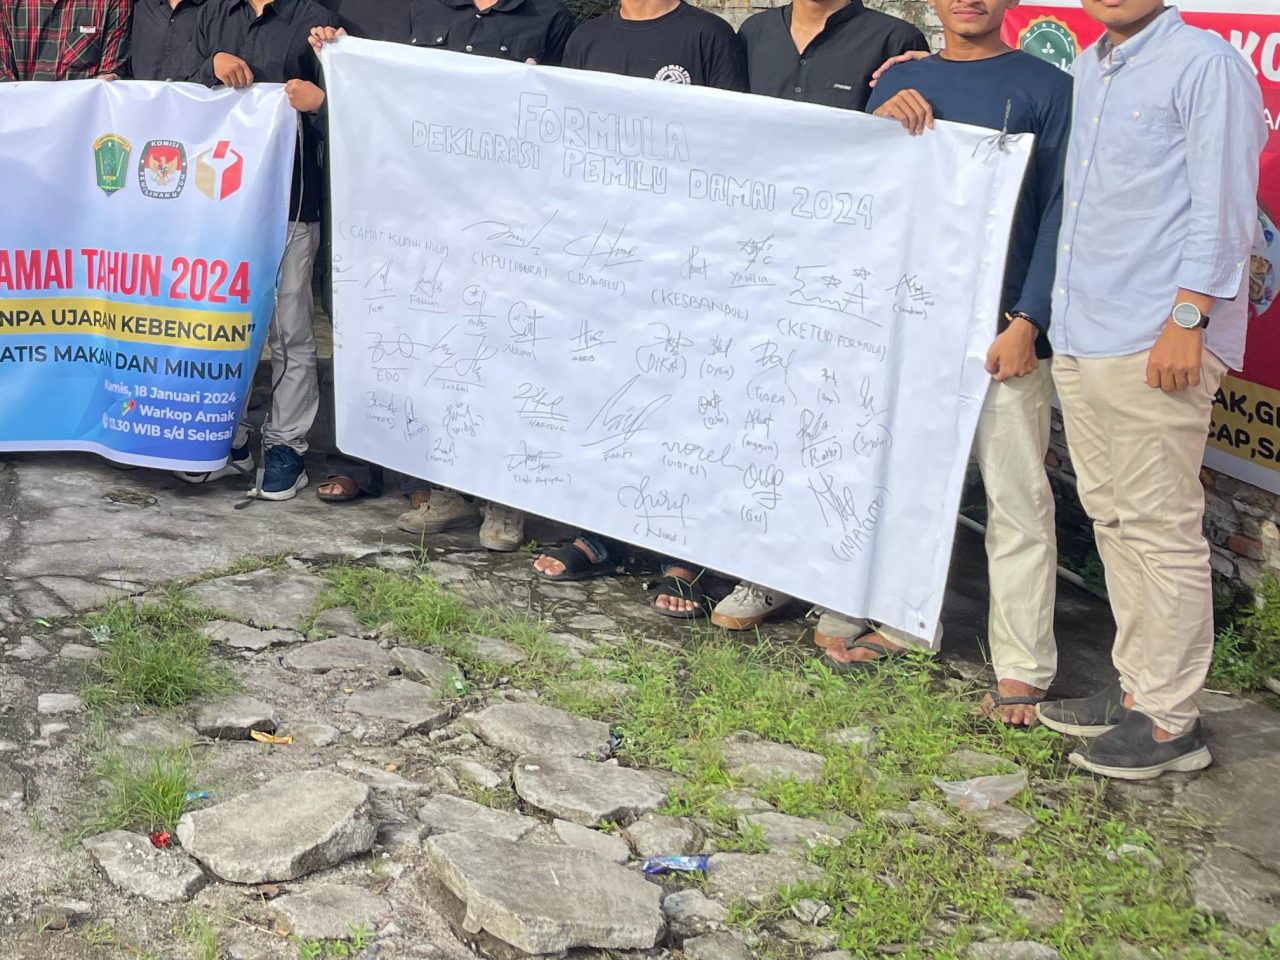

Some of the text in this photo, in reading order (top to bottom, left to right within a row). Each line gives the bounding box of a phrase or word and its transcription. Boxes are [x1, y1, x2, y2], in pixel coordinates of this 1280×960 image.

[151, 141, 180, 149] KOMISI
[411, 120, 875, 230] DEKLARASI PEMILU DAMAI 2024
[81, 248, 162, 297] TAHUN
[169, 256, 251, 304] 2024
[51, 309, 117, 331] UJARAN
[54, 346, 112, 367] MAKAN
[115, 352, 158, 374] DAN
[164, 360, 242, 380] MINUM
[135, 385, 147, 397] 18
[150, 387, 200, 404] Januari
[204, 392, 236, 404] 2024
[139, 404, 235, 423] Warkop Amak
[133, 422, 161, 437] WIB
[164, 426, 185, 440] s/d
[188, 427, 233, 441] Selesai
